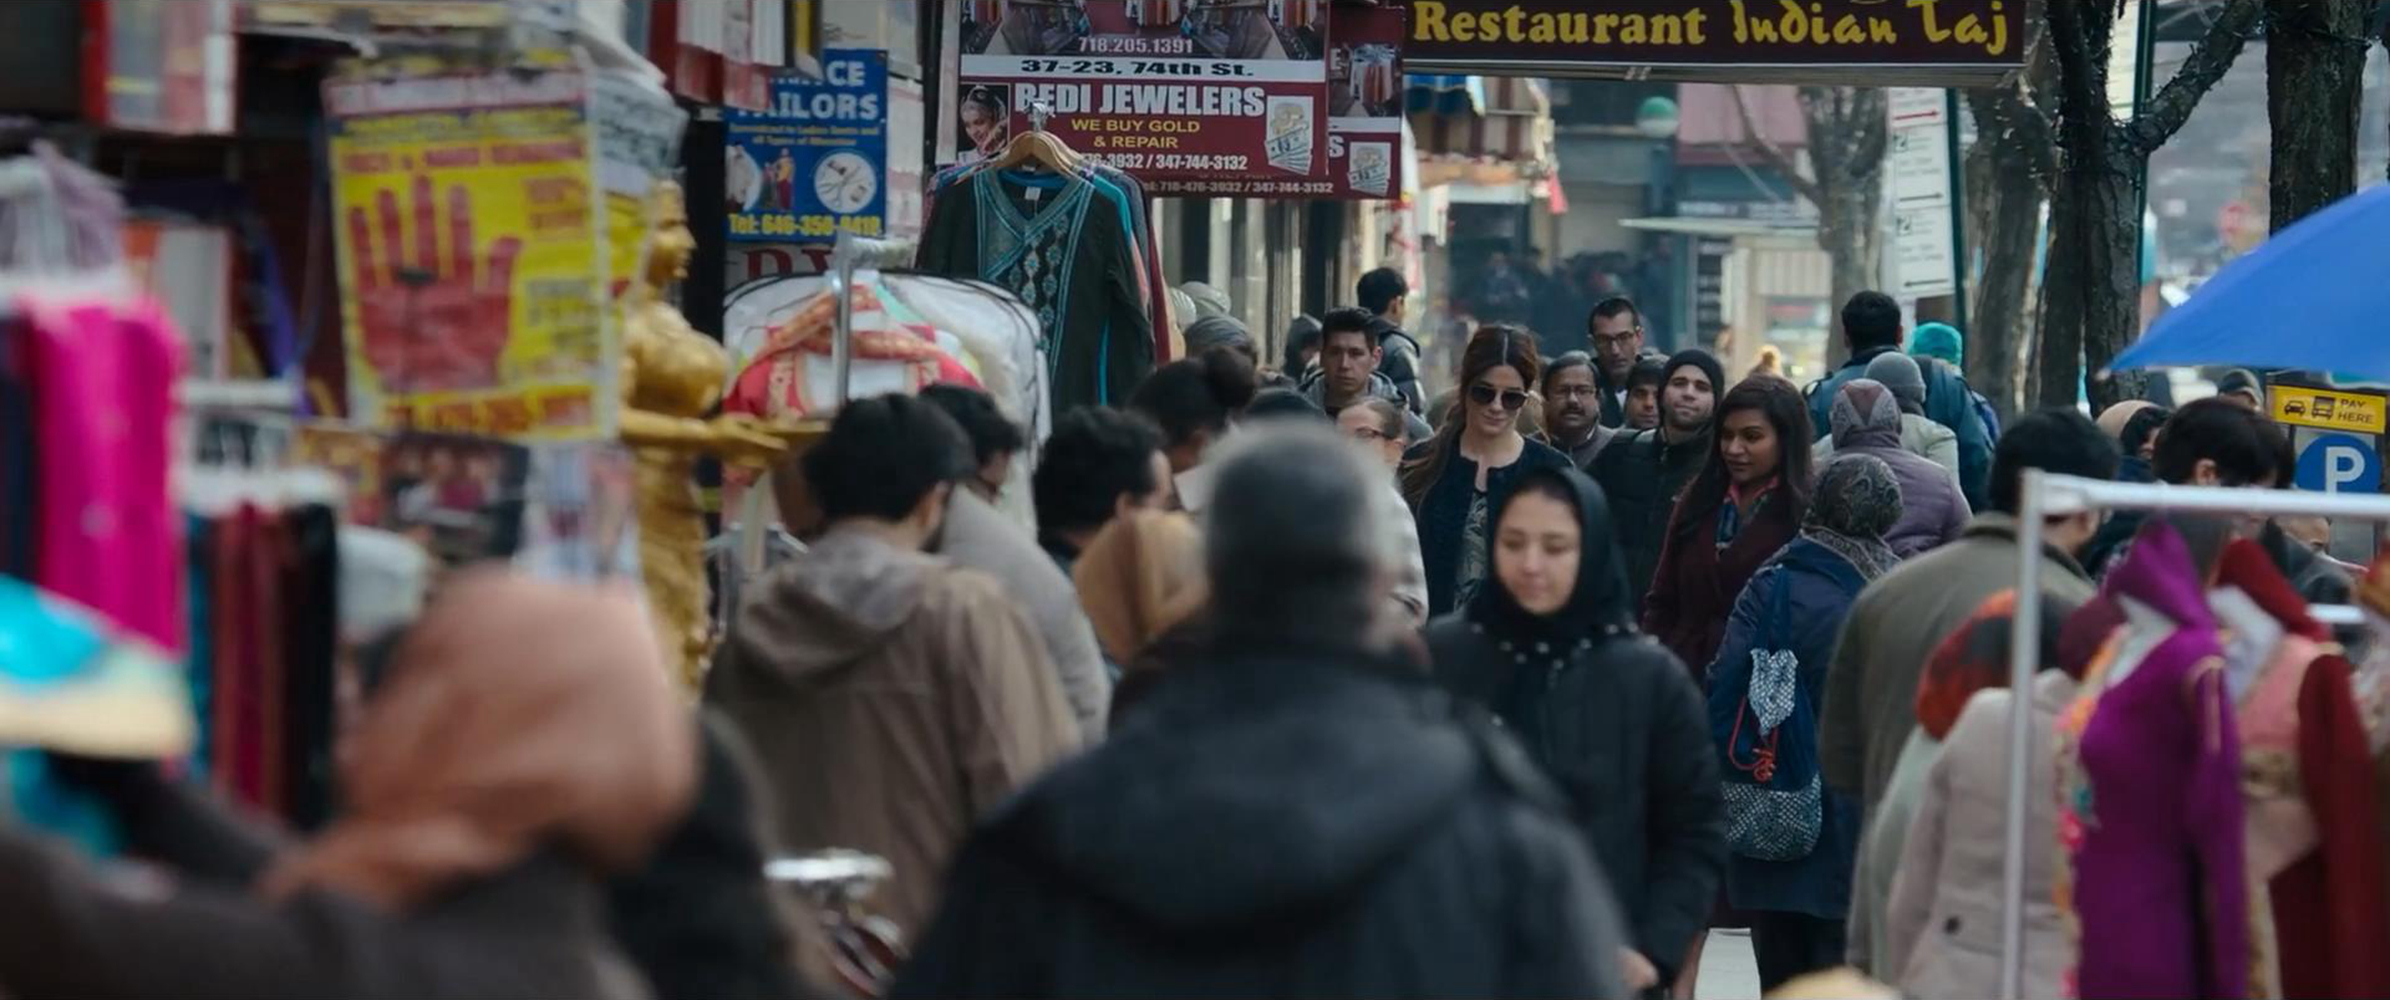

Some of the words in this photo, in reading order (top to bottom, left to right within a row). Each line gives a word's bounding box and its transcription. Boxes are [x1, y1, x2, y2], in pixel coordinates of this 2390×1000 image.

[1414, 1, 1706, 45] Restaurant
[1730, 0, 1896, 44] Indian
[1906, 0, 2008, 54] Taj
[1079, 36, 1193, 54] 718.205.1391
[1130, 61, 1201, 76] 74th
[1210, 63, 1254, 77] St.
[1014, 82, 1091, 113] BEDI
[1098, 83, 1265, 117] JEWELERS
[1071, 119, 1100, 131] WE
[1106, 119, 1144, 132] BUY
[1148, 120, 1200, 133] GOLD
[1093, 135, 1106, 148] &
[1112, 136, 1178, 149] REPAIR
[1155, 153, 1248, 171] 347-744-3132
[728, 212, 759, 235] Tel:
[2340, 398, 2366, 408] PAY
[2338, 411, 2374, 423] HERE
[2325, 446, 2365, 495] P
